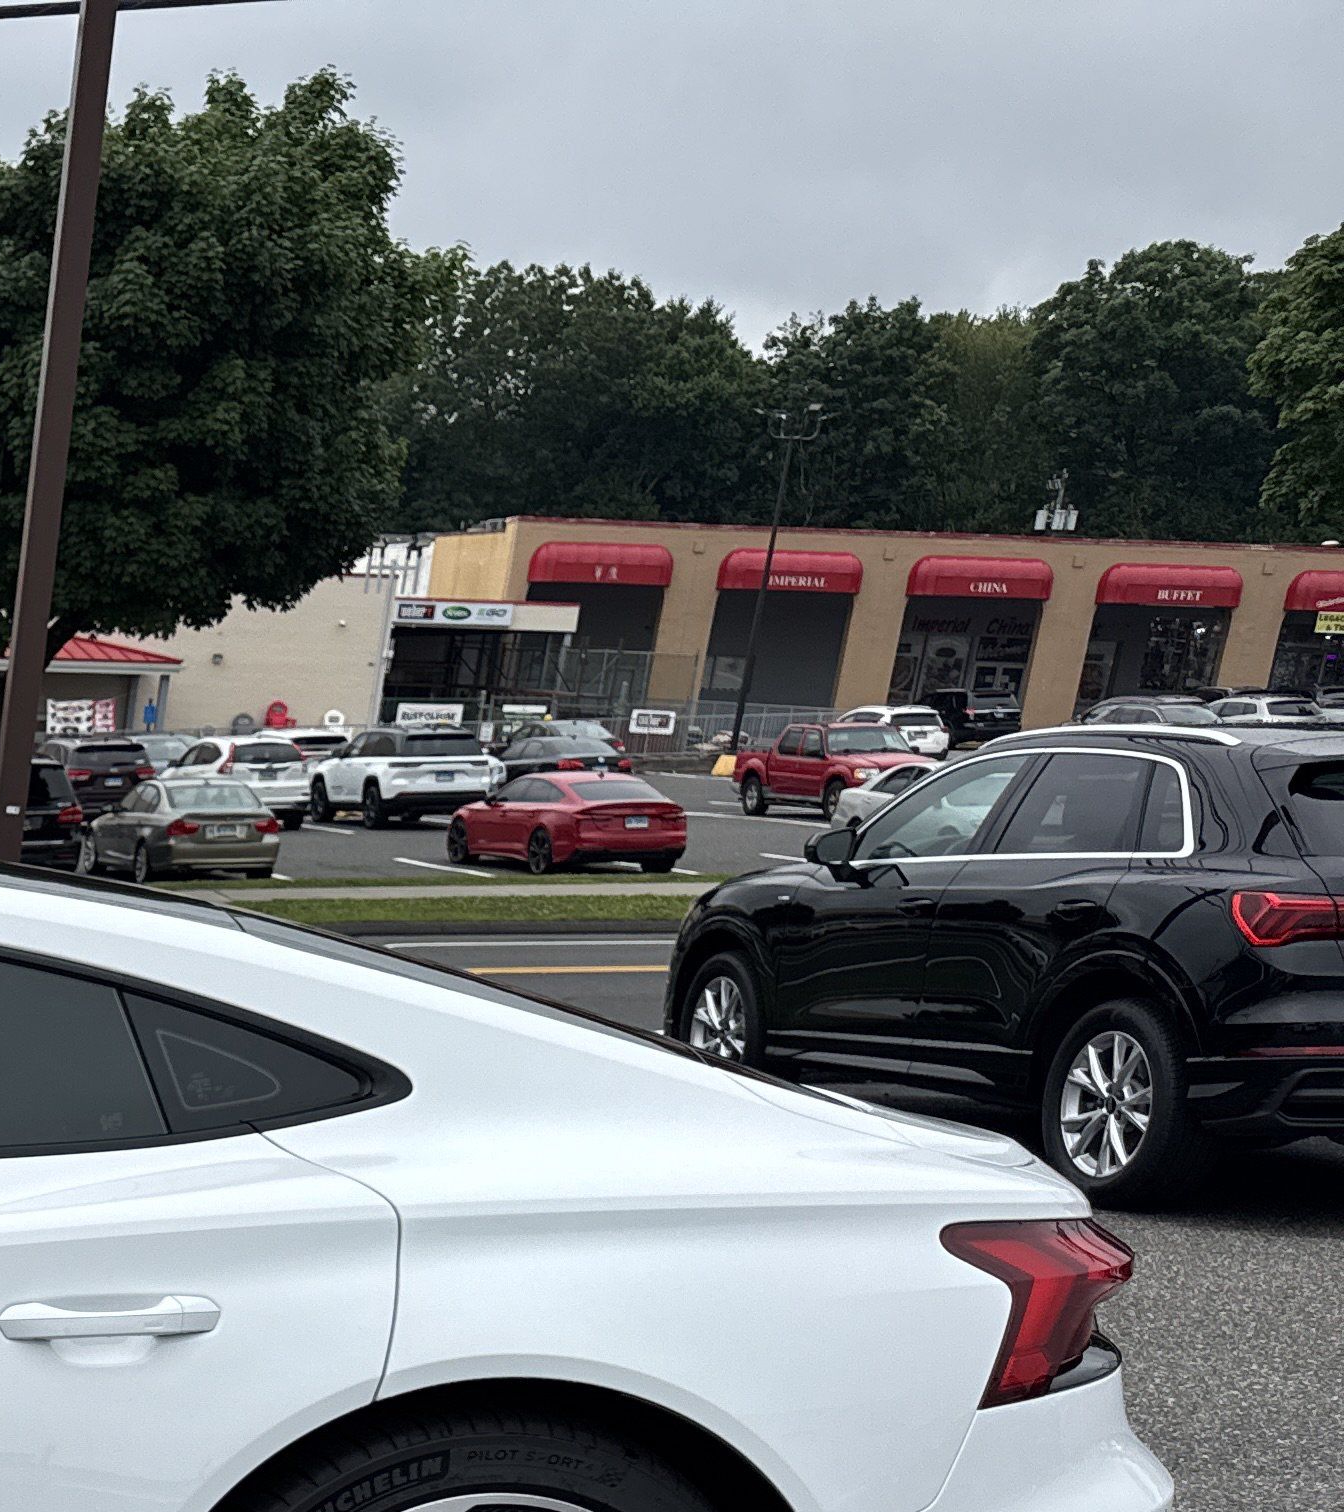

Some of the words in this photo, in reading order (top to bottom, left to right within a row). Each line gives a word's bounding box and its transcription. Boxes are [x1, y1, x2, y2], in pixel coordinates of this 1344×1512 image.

[768, 574, 827, 589] IMPERIAL
[969, 581, 1008, 595] CHINA
[1156, 588, 1204, 602] BUFFET
[467, 1448, 520, 1461] PILOT
